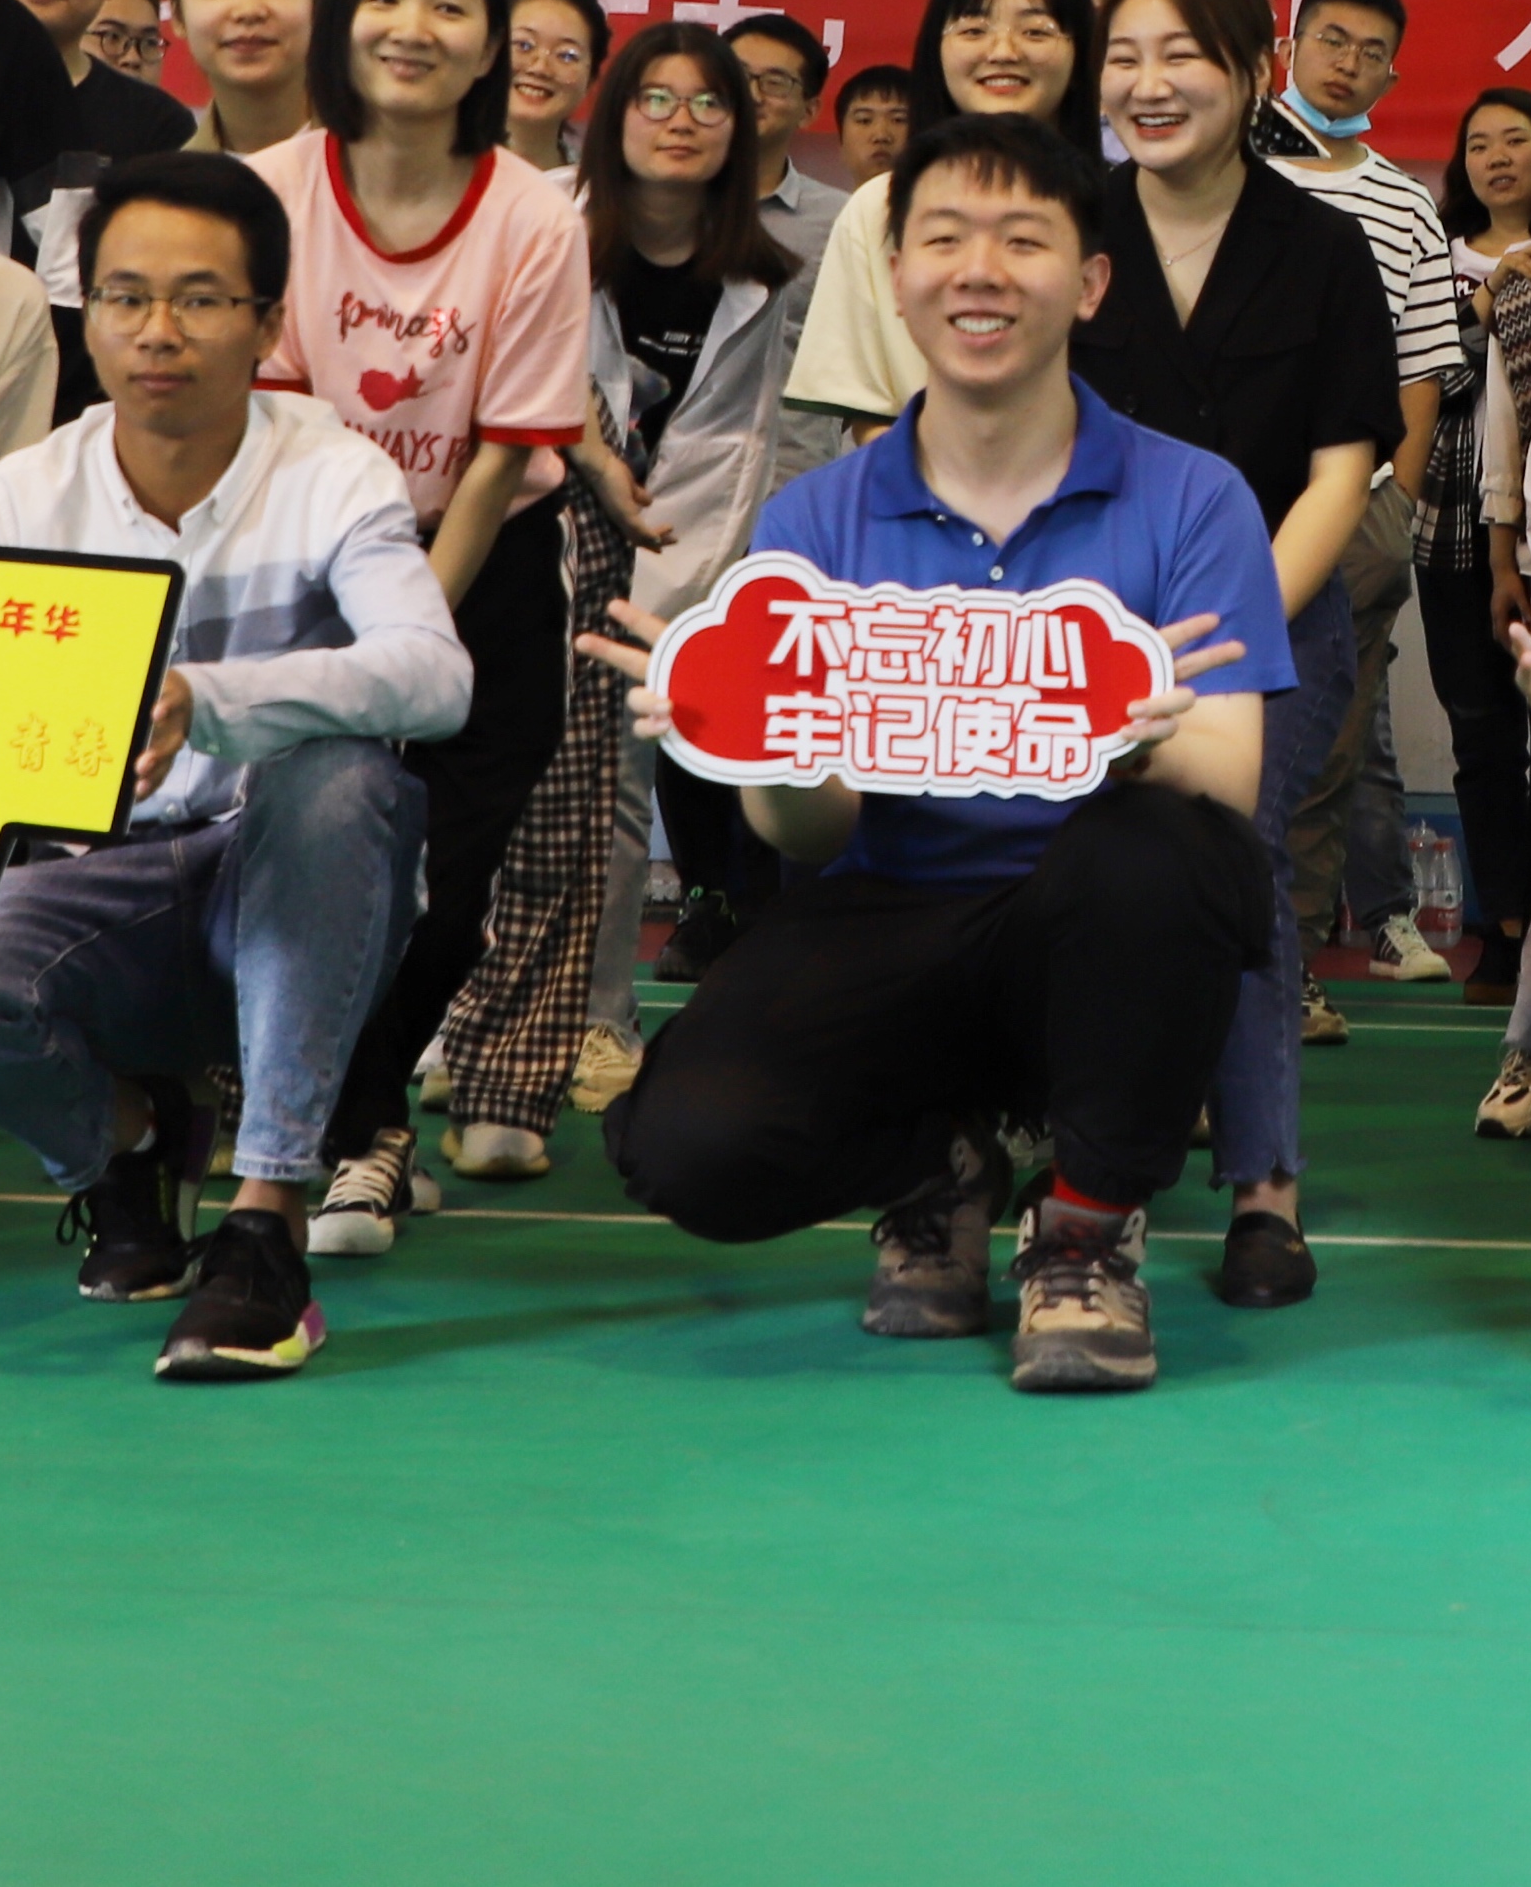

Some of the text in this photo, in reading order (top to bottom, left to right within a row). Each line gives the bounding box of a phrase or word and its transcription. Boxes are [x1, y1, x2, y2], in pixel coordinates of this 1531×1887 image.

[769, 599, 1088, 689] 不忘初心
[764, 692, 1092, 782] 牢记使命
